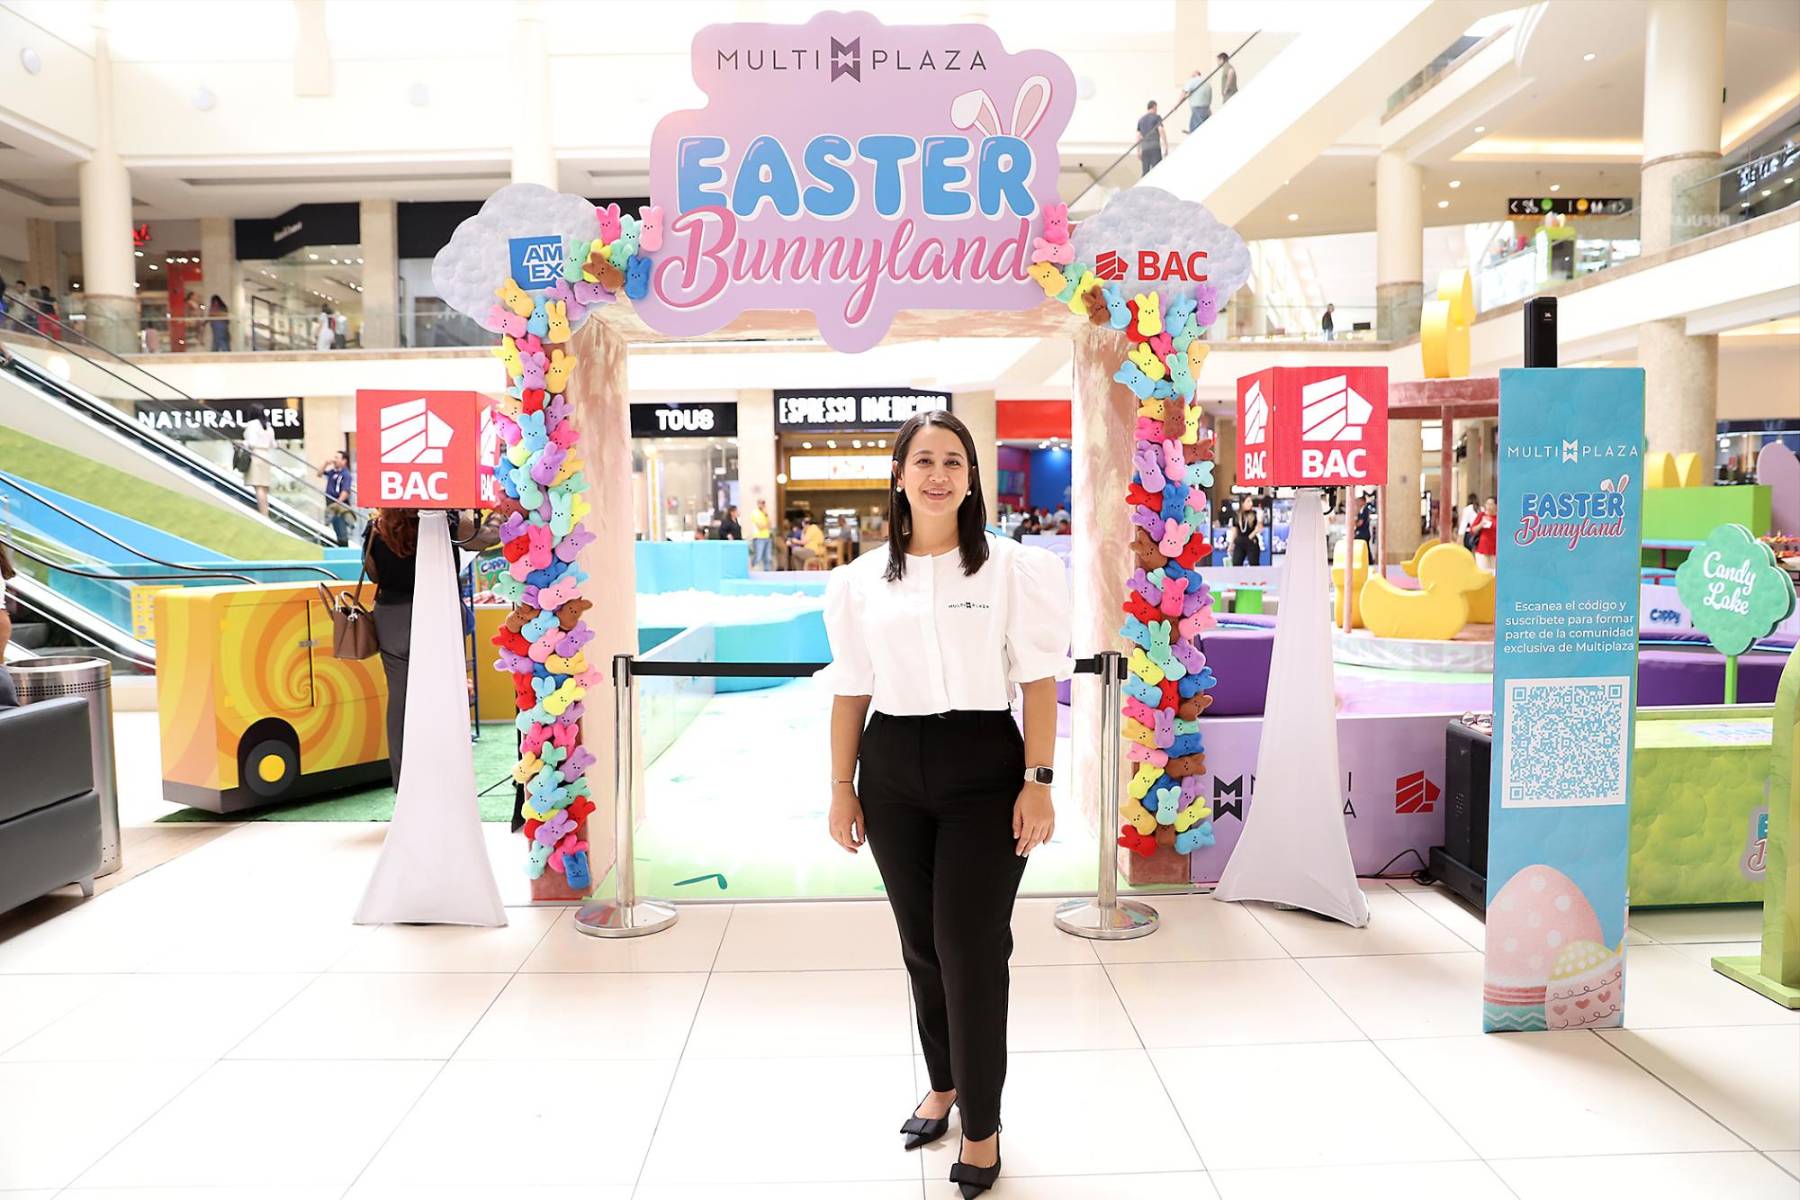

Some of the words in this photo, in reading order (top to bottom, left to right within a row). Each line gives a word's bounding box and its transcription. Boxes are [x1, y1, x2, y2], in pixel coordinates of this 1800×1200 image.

[718, 50, 819, 70] MULTI
[872, 50, 987, 70] PLAZA
[677, 135, 1036, 218] EASTER
[653, 205, 1031, 325] Bunnyland
[1137, 250, 1208, 282] BAC
[138, 408, 300, 431] NATURALER
[655, 408, 715, 431] TOUS
[1244, 450, 1268, 481] BAC
[1301, 448, 1367, 479] BAC
[1507, 445, 1559, 458] MULTI
[1582, 445, 1639, 457] PLAZA
[380, 471, 448, 501] BAC
[1521, 492, 1626, 520] EASTER
[1513, 514, 1627, 552] Bunnyland
[1703, 551, 1757, 596] Candy
[1515, 602, 1562, 612] Escanea
[1565, 600, 1576, 611] el
[1578, 599, 1617, 611] código
[1619, 602, 1627, 612] y
[1703, 582, 1749, 616] Lake
[1505, 630, 1537, 641] parte
[1538, 629, 1554, 639] de
[1556, 628, 1567, 638] la
[1569, 626, 1634, 638] comunidad
[1567, 616, 1593, 626] para
[1596, 614, 1635, 624] formar
[1503, 642, 1556, 654] exclusiva
[1558, 641, 1573, 653] de
[1575, 640, 1635, 653] Multiplaza
